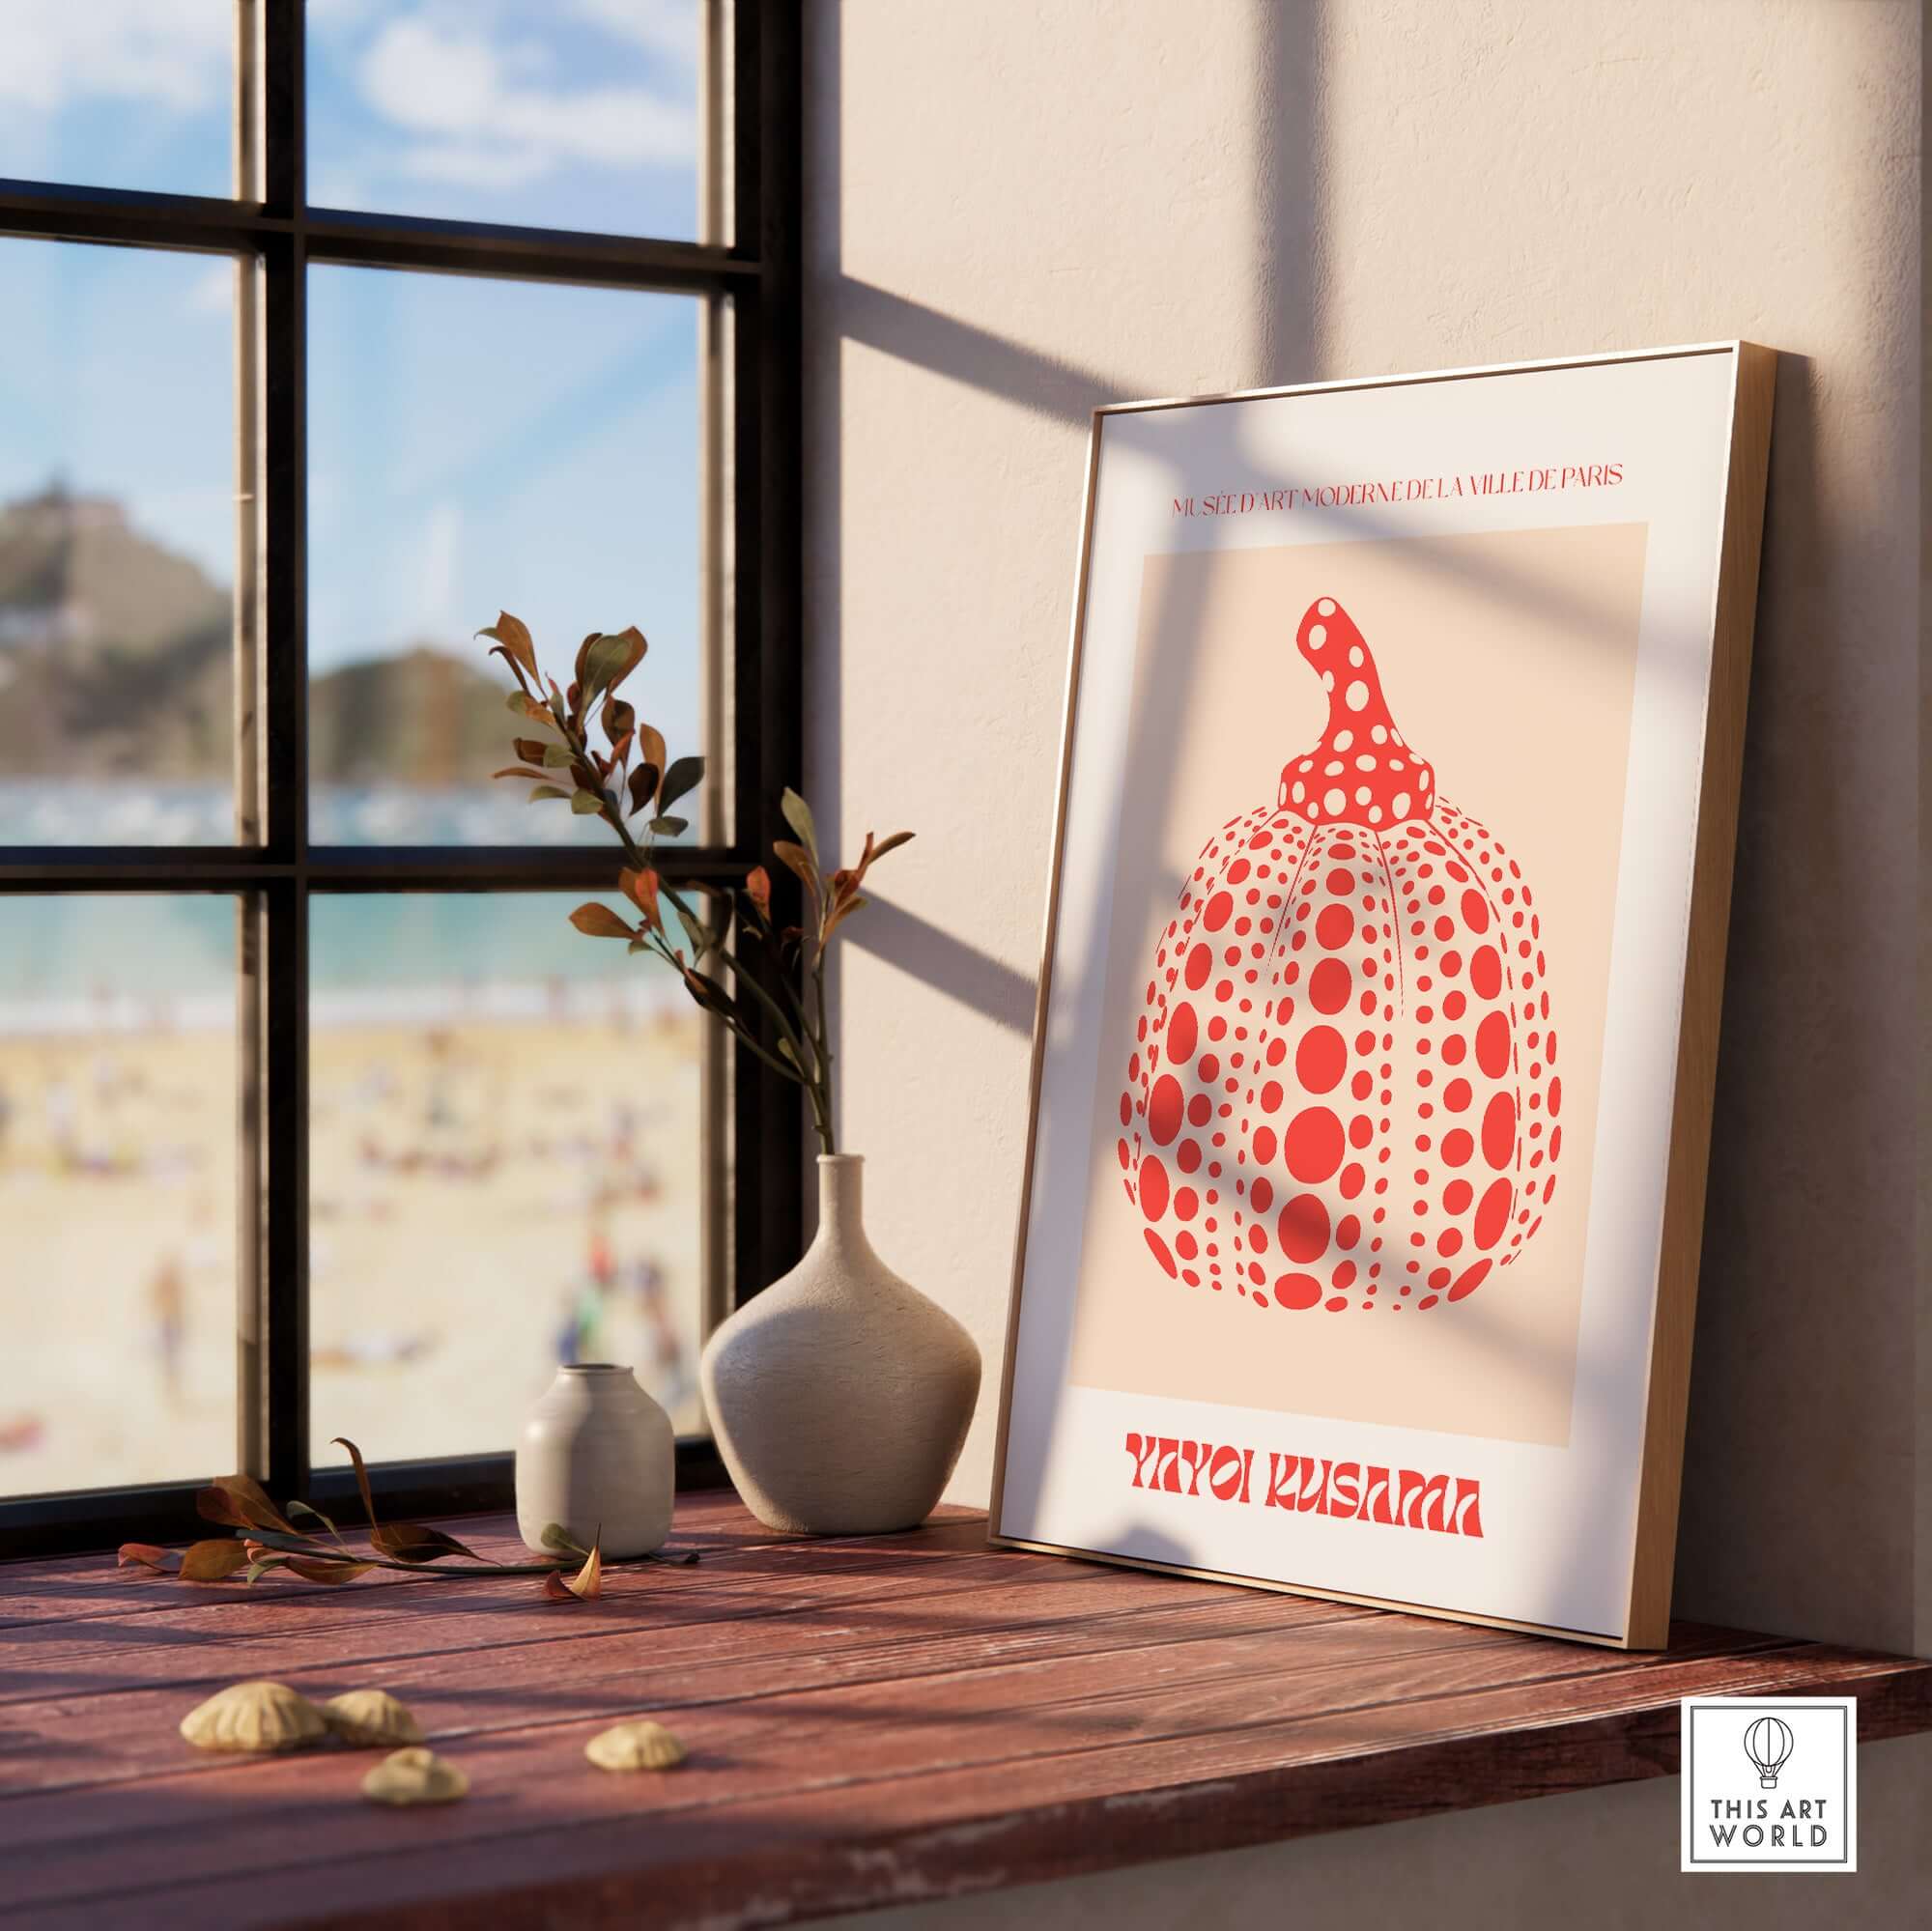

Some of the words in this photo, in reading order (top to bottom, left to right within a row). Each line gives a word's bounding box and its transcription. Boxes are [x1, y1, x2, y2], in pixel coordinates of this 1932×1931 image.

[1172, 491, 1236, 518] MUSÉE
[1303, 480, 1404, 508] MODERNE
[1406, 478, 1434, 501] DE
[1437, 476, 1463, 498] LA
[1469, 470, 1524, 496] VILLE
[1528, 469, 1557, 492] DE
[1561, 463, 1624, 489] PARIS
[1126, 1433, 1255, 1503] YAYOI
[1264, 1452, 1484, 1538] KUSAMA
